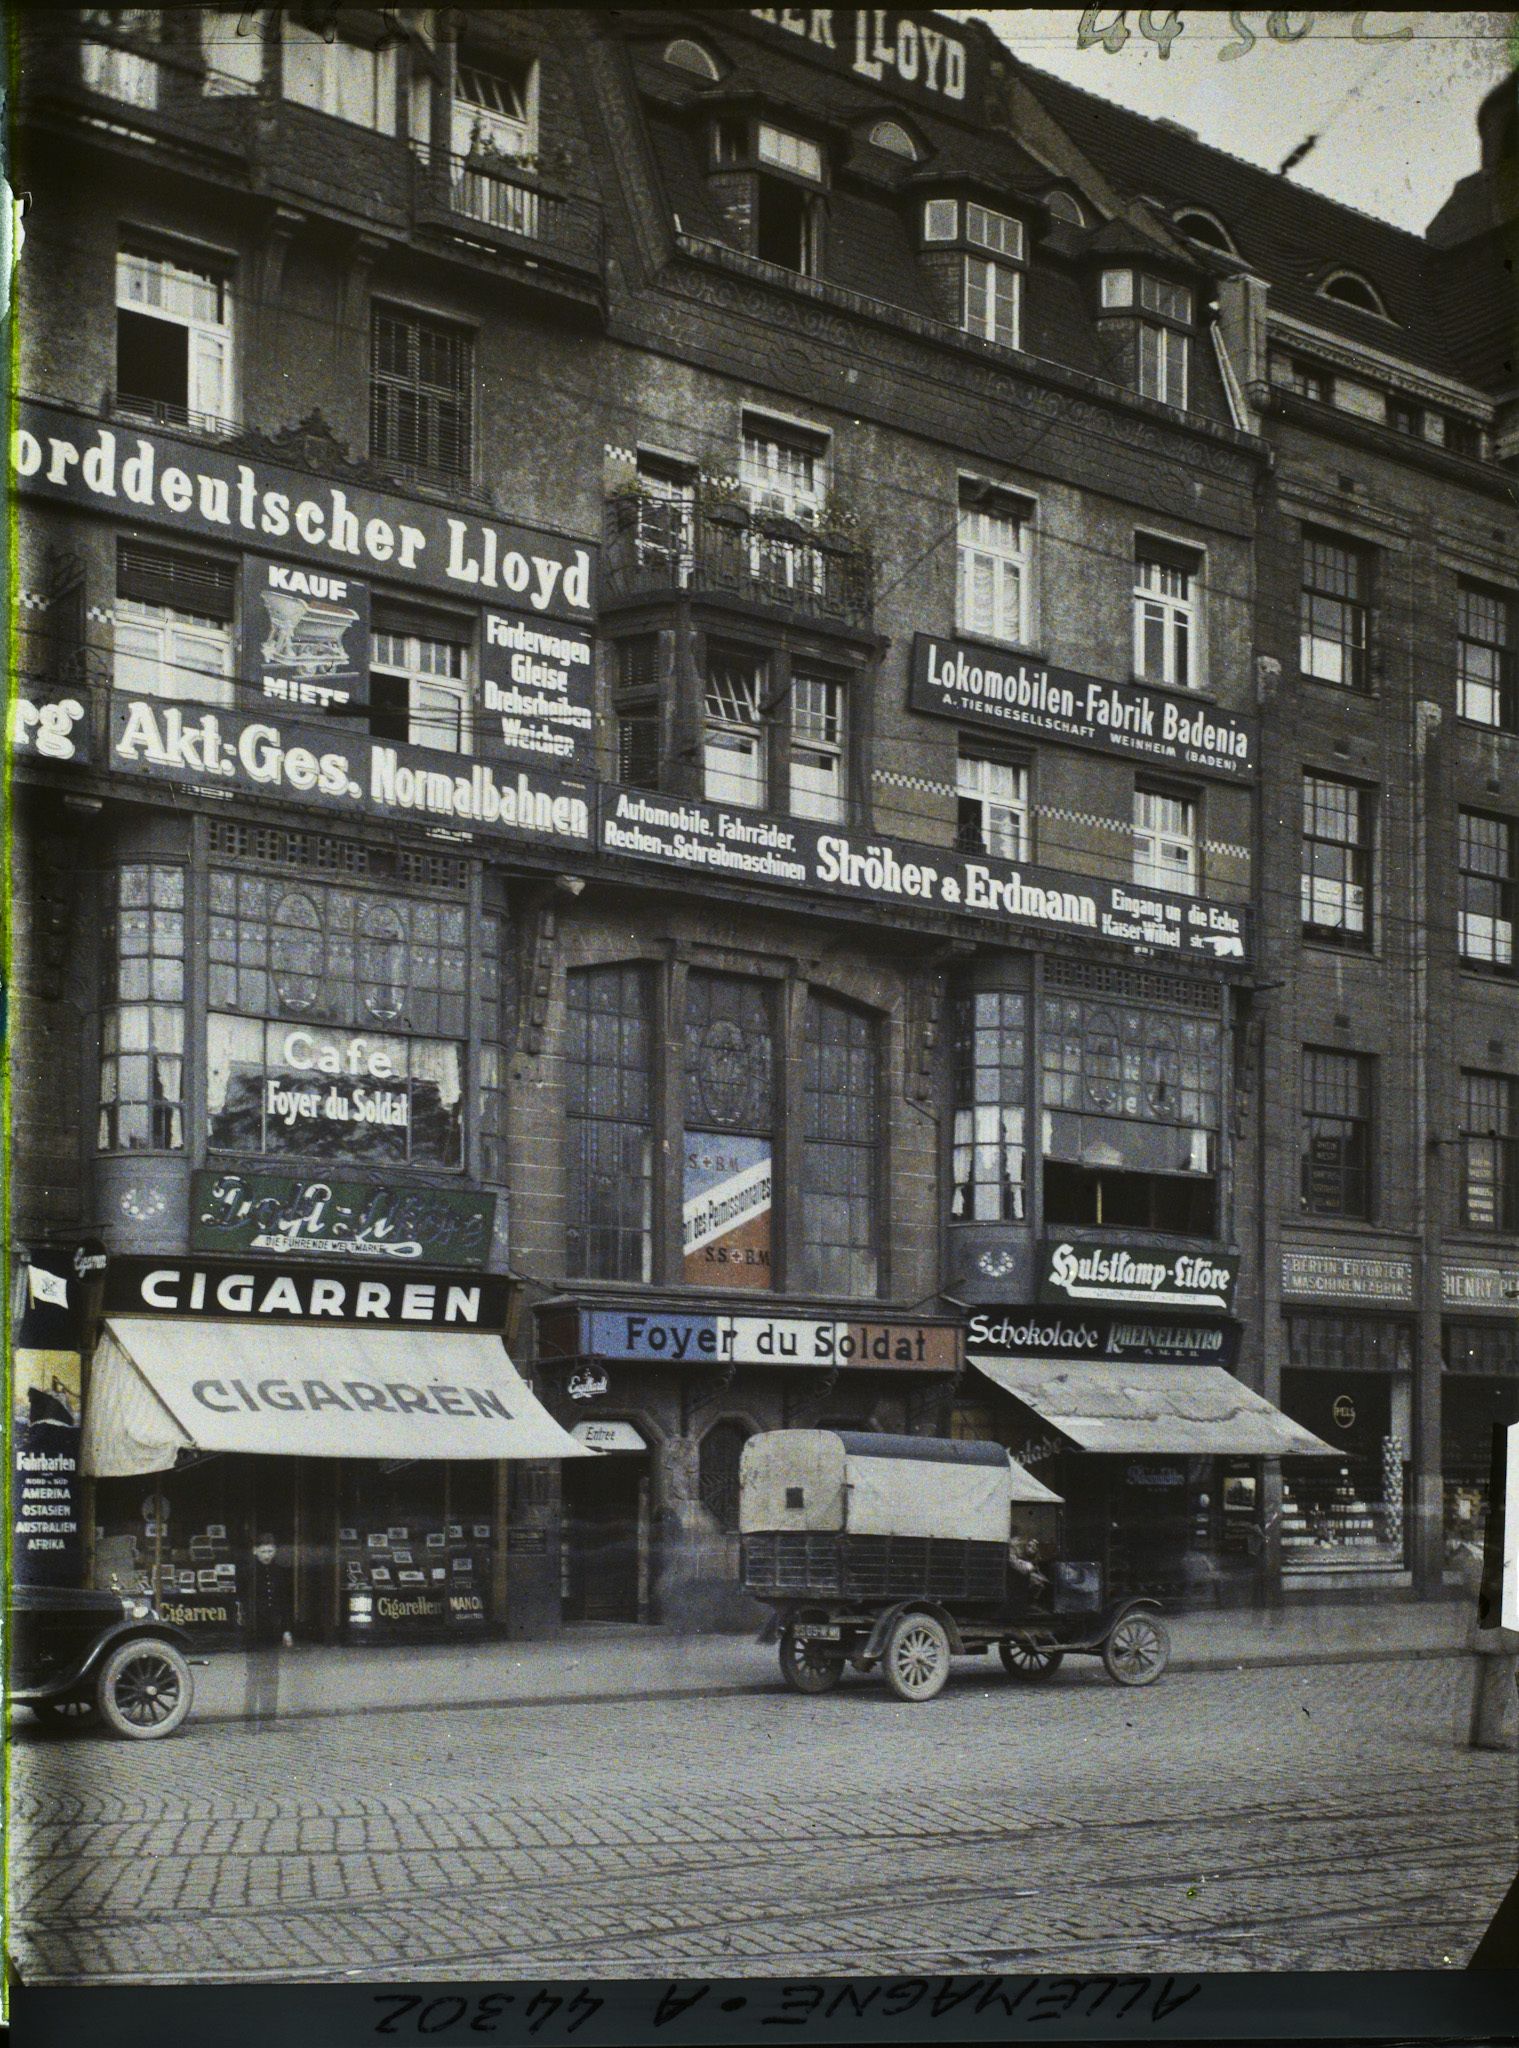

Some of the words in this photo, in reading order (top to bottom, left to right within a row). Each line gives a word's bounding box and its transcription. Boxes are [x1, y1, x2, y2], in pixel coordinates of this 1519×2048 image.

[268, 565, 347, 601] KAUF
[446, 518, 592, 610] Lloyd
[263, 675, 350, 707] MIETE
[511, 653, 568, 692] Gleise
[484, 679, 592, 730] Drehscheiben
[927, 644, 1154, 736] Lokomobilen-Fabrik
[1163, 702, 1248, 758] Badenia
[942, 693, 1096, 738] ATIENGESELLSCHAFT
[1109, 732, 1177, 757] WEINHEIM
[1185, 750, 1237, 772] (BADEN)
[370, 746, 588, 839] Normalbahnen
[816, 835, 937, 898] Ströher
[941, 877, 961, 903] &
[964, 864, 1098, 927] Erdmann
[1111, 888, 1163, 922] Eingang
[1188, 904, 1208, 927] die
[1209, 907, 1239, 933] Ecke
[267, 1080, 322, 1126] Foyer
[325, 1086, 349, 1120] du
[352, 1088, 408, 1127] Soldat
[265, 1235, 282, 1248] DIE
[1048, 1243, 1231, 1291] Hulstkamp-Liköre
[1445, 1275, 1494, 1298] HENRY
[140, 1269, 481, 1323] CIGARREN
[626, 1317, 738, 1359] Foyer
[757, 1323, 798, 1357] du
[815, 1325, 927, 1362] Soldat
[967, 1314, 1099, 1349] Schokolade
[192, 1379, 516, 1420] CIGARREN
[16, 1451, 76, 1471] Fahrkarten
[21, 1504, 71, 1516] OSTASIEN
[22, 1487, 71, 1499] AMERIKA
[15, 1521, 77, 1533] AUSTRALIEN
[27, 1539, 66, 1550] AFRIKA
[160, 1602, 227, 1625] Cigarren
[761, 1975, 1202, 2026] ALLEMAGNE
